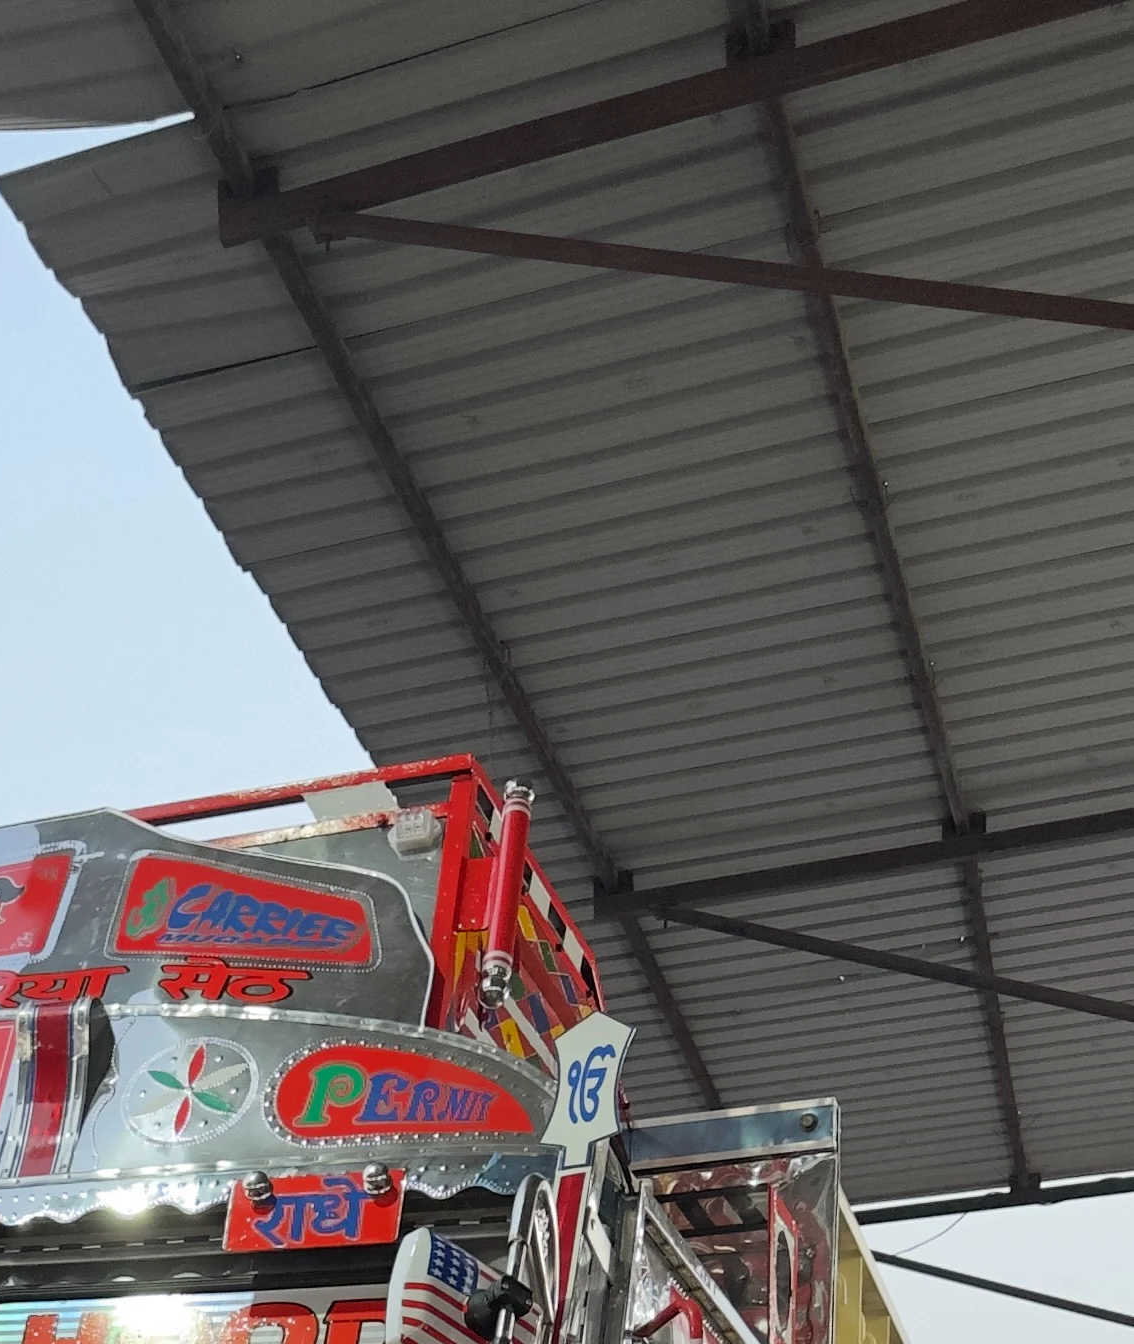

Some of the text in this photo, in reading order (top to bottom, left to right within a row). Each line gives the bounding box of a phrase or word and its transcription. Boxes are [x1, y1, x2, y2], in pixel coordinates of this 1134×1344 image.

[168, 883, 359, 942] CARRIER
[158, 956, 314, 1004] सेठ
[294, 1061, 498, 1126] PERMIT
[253, 1178, 365, 1247] राधे
